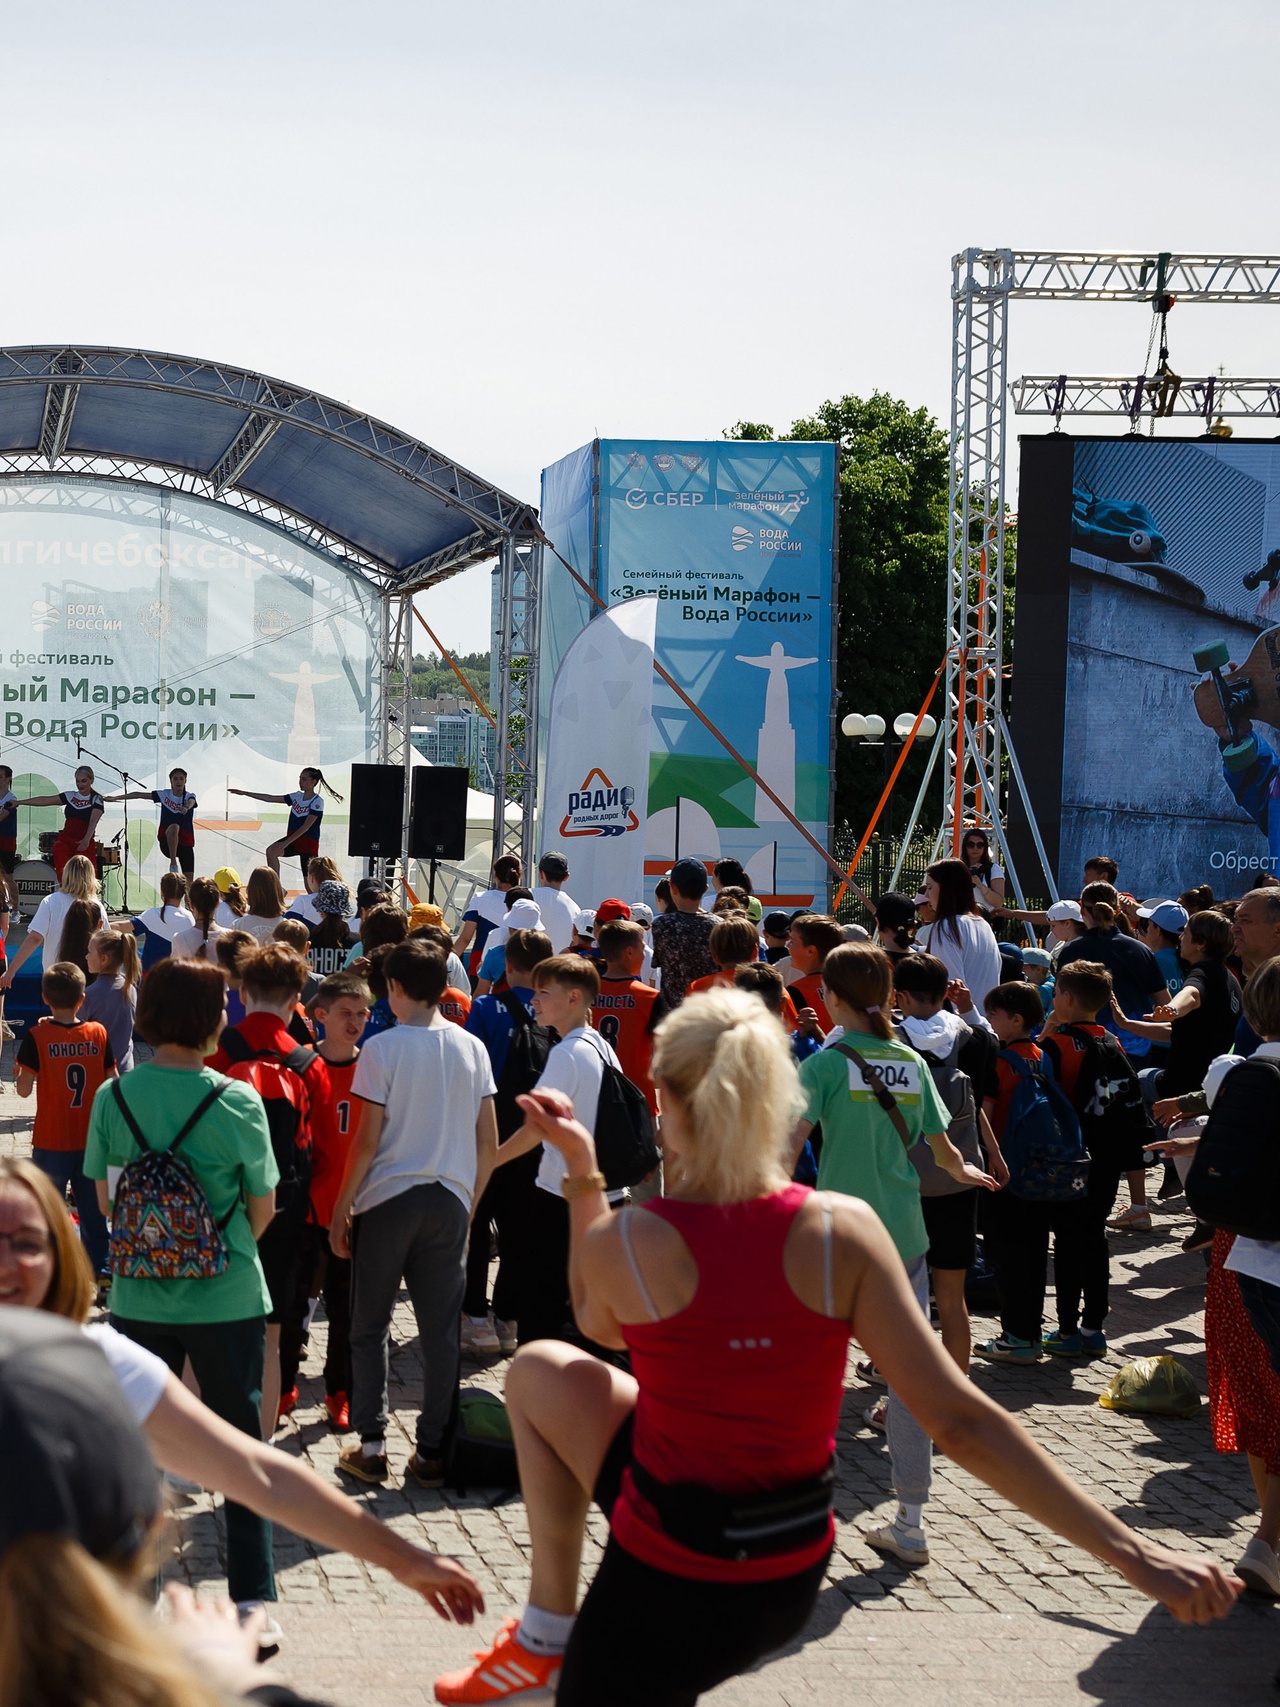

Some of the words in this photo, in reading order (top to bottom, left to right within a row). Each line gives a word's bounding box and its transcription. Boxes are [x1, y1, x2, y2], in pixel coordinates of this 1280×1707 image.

[653, 492, 704, 507] СБЕР
[735, 490, 785, 501] зелёный
[728, 502, 780, 513] марафон
[759, 529, 789, 540] ВОДА
[759, 541, 802, 551] РОССИИ
[623, 569, 682, 579] Семейный
[685, 569, 744, 581] фестиваль
[714, 586, 801, 606] Марафон
[67, 604, 105, 616] ВОДА
[682, 606, 730, 624] Вода
[736, 606, 813, 623] России»
[67, 618, 123, 630] РОССИИ
[9, 649, 115, 668] фестиваль
[60, 678, 217, 711] Марафон
[4, 712, 89, 742] Вода
[101, 713, 241, 742] России»
[573, 814, 599, 824] родных
[599, 812, 619, 822] дорог
[47, 1041, 100, 1059] ЮНОСТЬ
[65, 1062, 87, 1109] 9
[336, 1100, 350, 1134] 1
